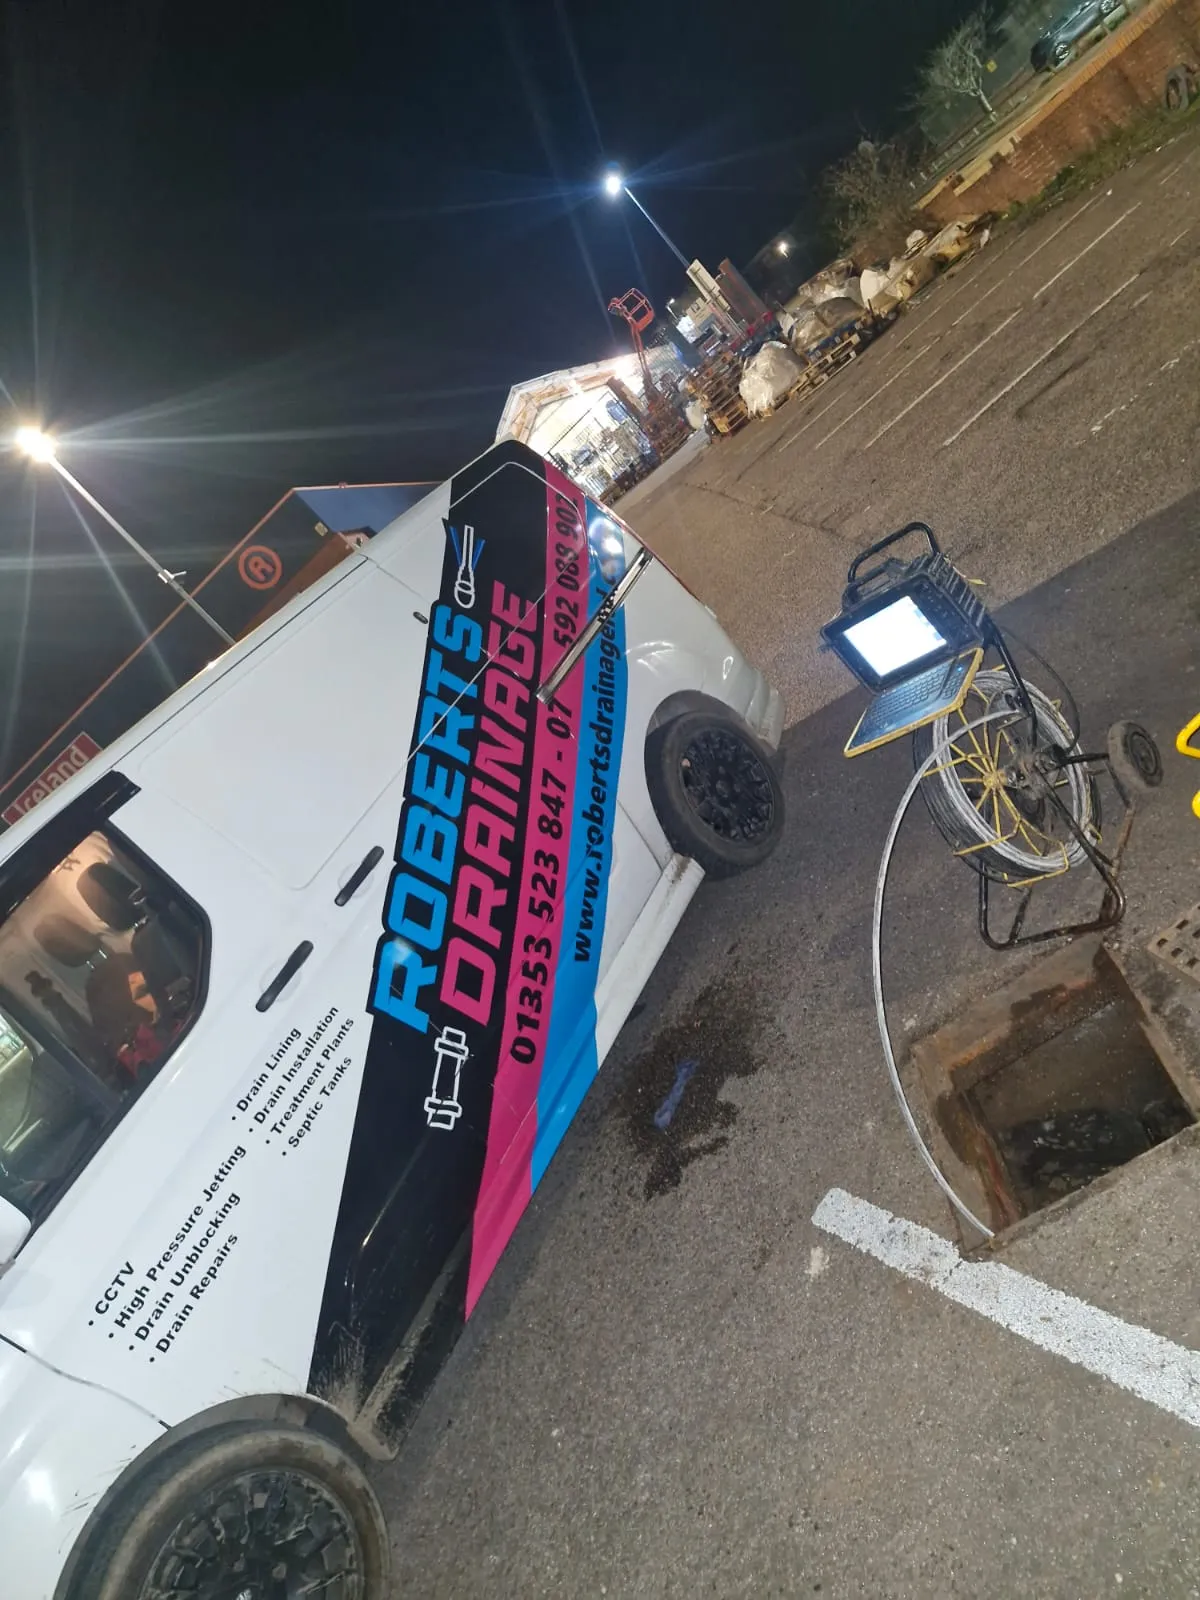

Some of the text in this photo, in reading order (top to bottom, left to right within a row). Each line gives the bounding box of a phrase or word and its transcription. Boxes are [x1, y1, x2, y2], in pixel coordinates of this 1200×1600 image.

[555, 543, 580, 592] 088
[14, 744, 89, 815] Iceland
[373, 604, 483, 1034] ROBERTS
[440, 580, 539, 1027] DRAINAGE
[538, 768, 567, 840] 847
[528, 848, 560, 923] 523
[510, 934, 553, 1064] 01353
[237, 1027, 302, 1112] Drain Lining
[254, 1006, 338, 1124] Drain Installation
[270, 1018, 354, 1135] Treatment Plants
[288, 1056, 352, 1148] Septic Tanks
[95, 1261, 136, 1315] CCTV
[114, 1145, 246, 1329] High Pressure Jetting
[135, 1192, 241, 1341] Drain Unblocking
[156, 1233, 238, 1353] Drain Repairs
